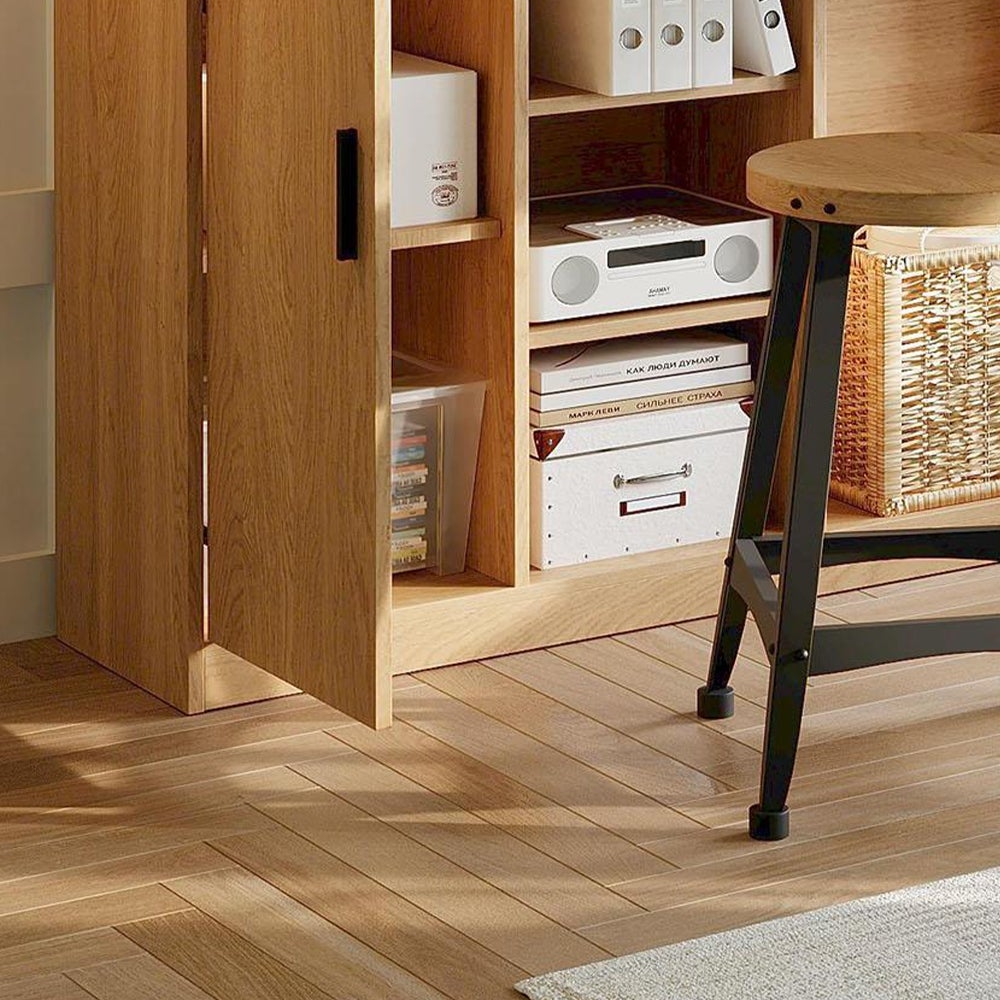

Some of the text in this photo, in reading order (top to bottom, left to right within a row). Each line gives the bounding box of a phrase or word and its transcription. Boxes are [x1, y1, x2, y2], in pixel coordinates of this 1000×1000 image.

[626, 354, 720, 375] КАК ЛЮДИ ДУМАЮТ
[568, 389, 723, 420] МАРК ЛЕВИ СИЛЬНЕЕ СТРАХА
